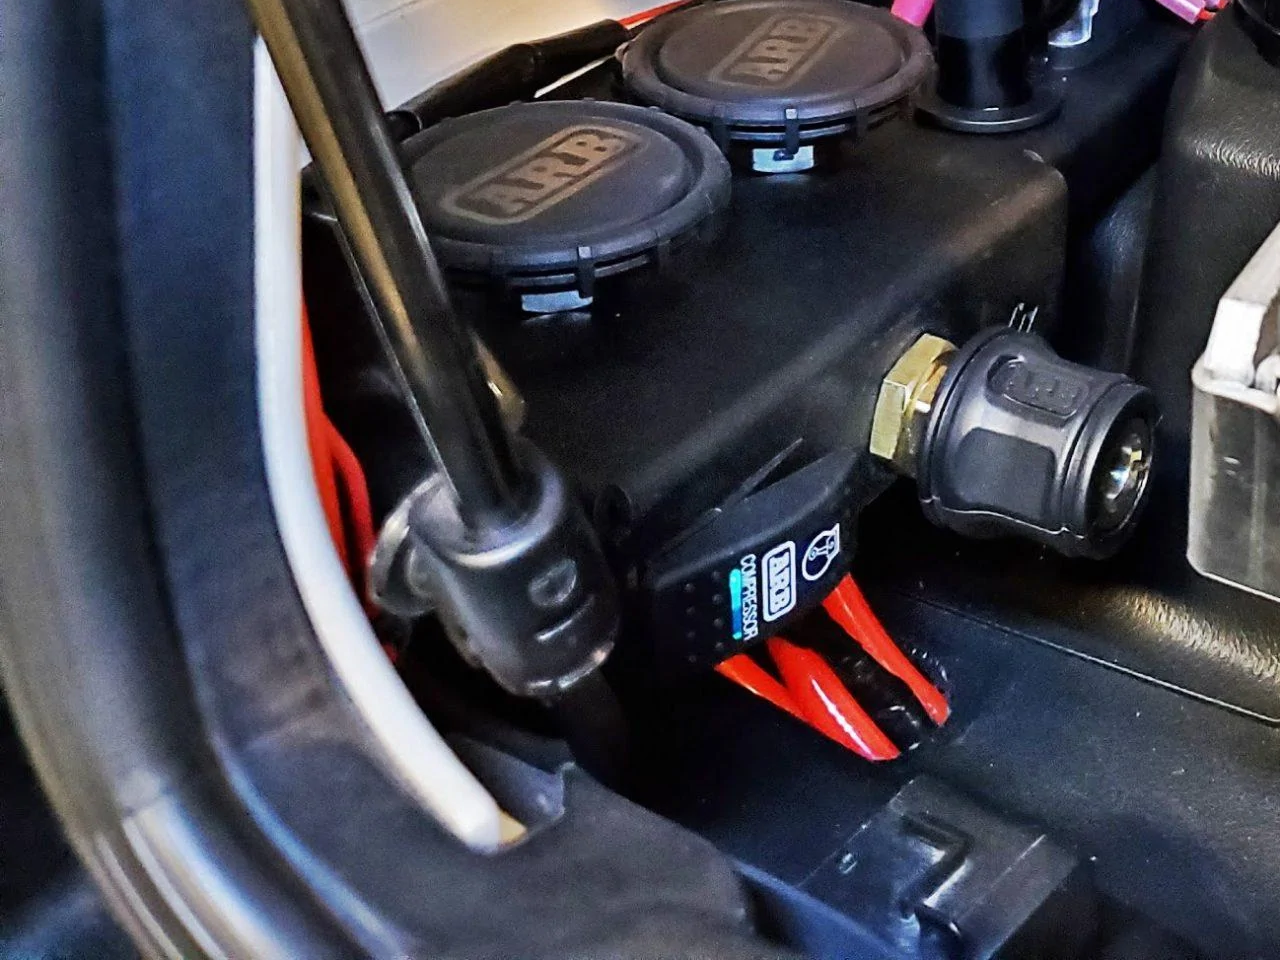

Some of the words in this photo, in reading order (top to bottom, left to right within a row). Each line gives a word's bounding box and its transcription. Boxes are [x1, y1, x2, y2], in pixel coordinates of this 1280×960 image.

[730, 19, 832, 82] ARB
[474, 133, 627, 216] ARB
[740, 553, 758, 641] COMPRESSOR
[767, 549, 791, 615] ARB
